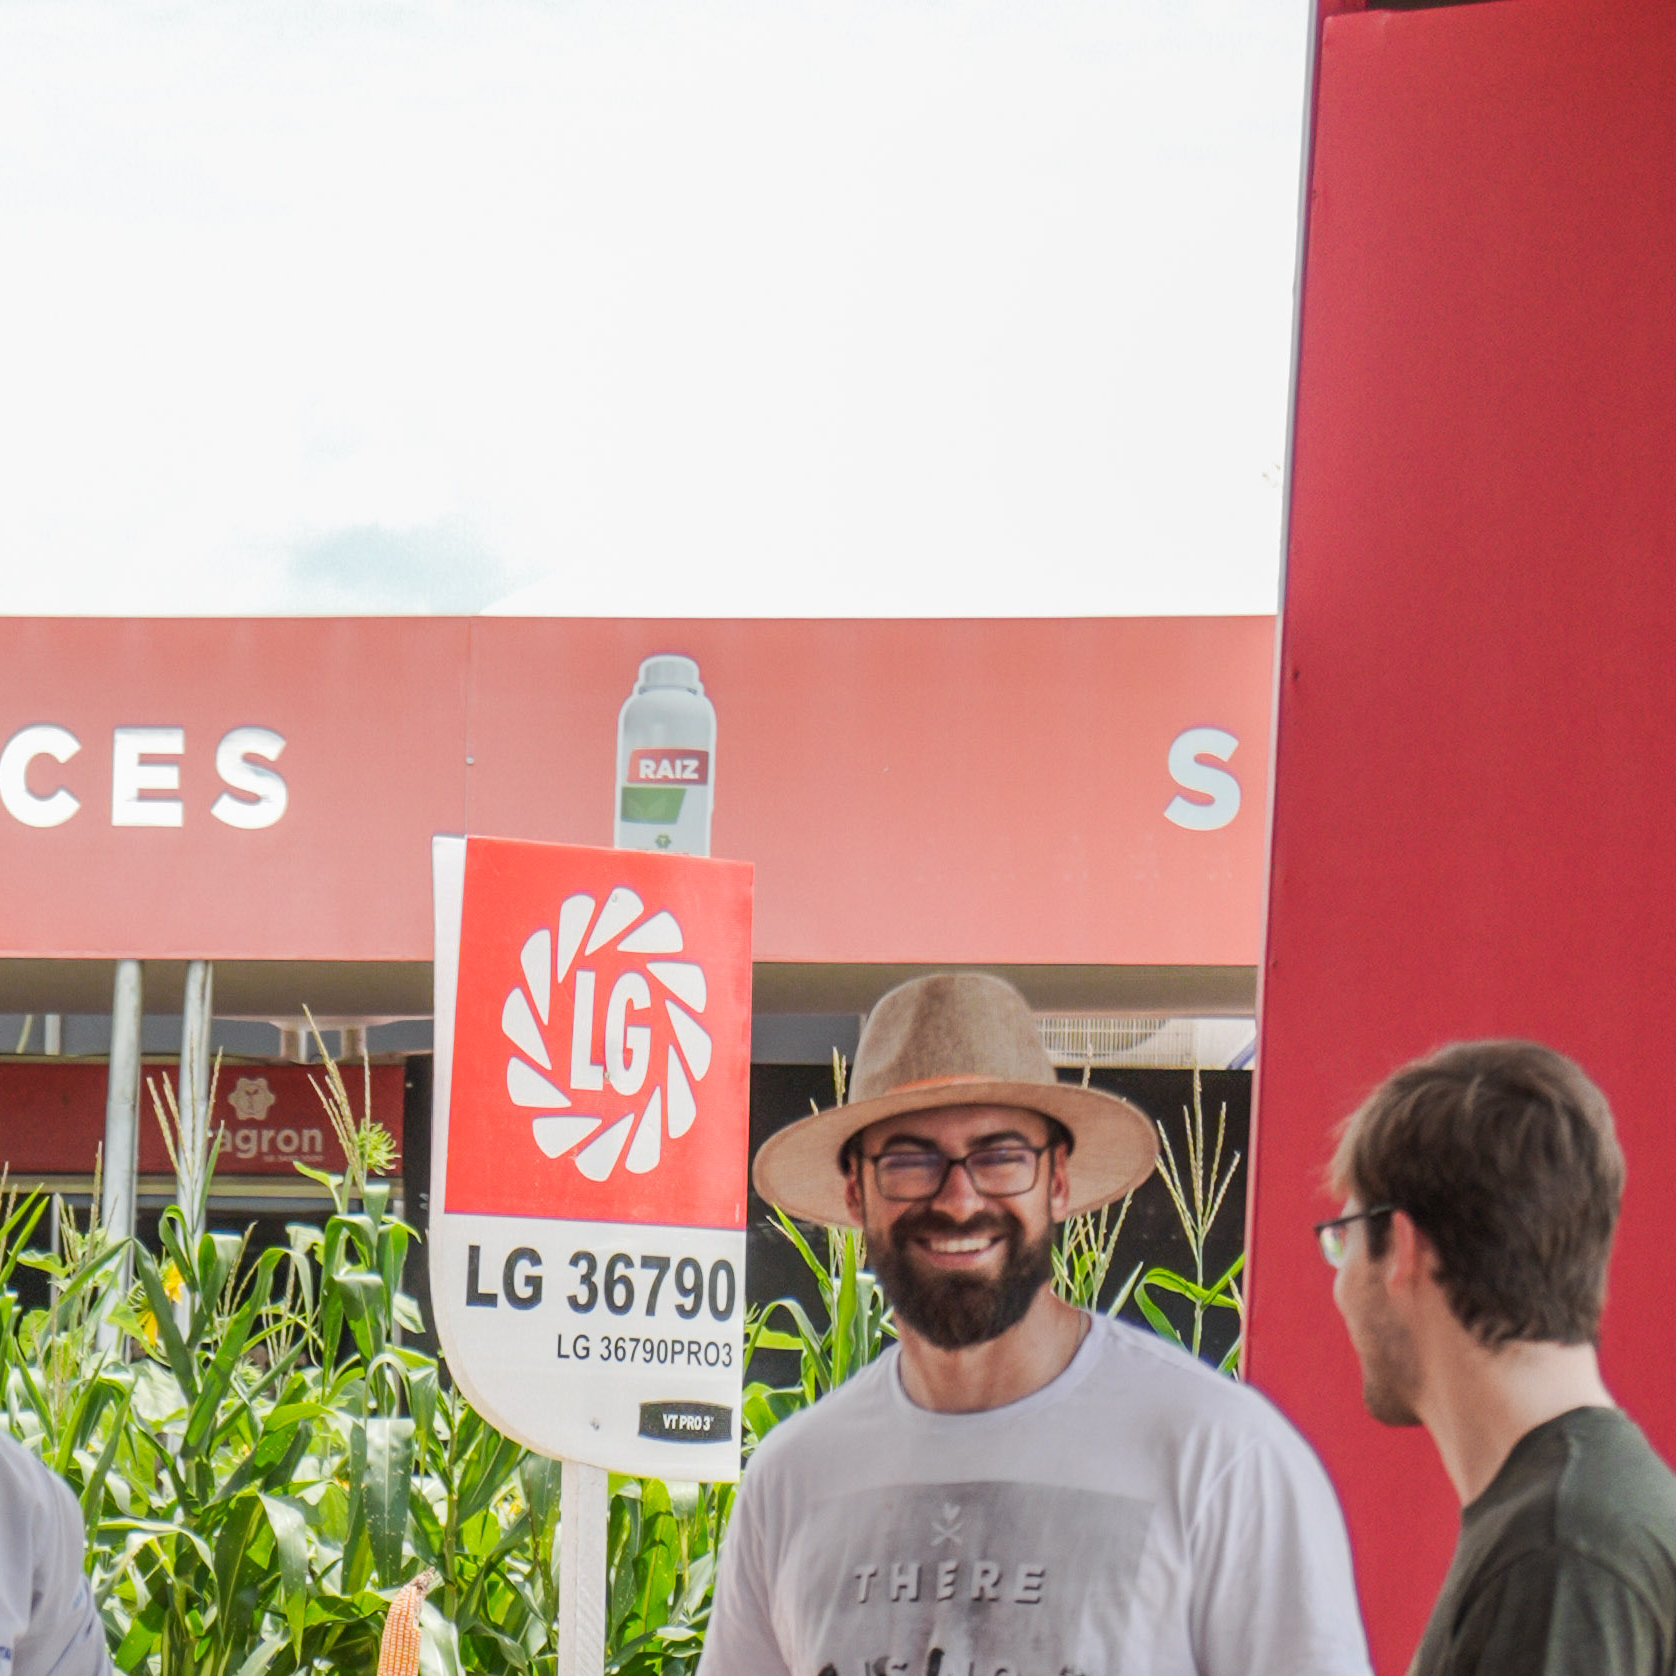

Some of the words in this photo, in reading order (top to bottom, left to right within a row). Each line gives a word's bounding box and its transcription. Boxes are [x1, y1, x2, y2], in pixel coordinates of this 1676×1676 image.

[639, 758, 699, 780] RAIZ
[570, 970, 652, 1096] LG
[466, 1245, 543, 1310] LG
[567, 1250, 736, 1322] 36790
[557, 1334, 591, 1360] LG
[600, 1336, 733, 1368] 36790PRO3
[663, 1413, 679, 1430] VT
[679, 1414, 702, 1431] PRO
[854, 1560, 1046, 1604] THERE
